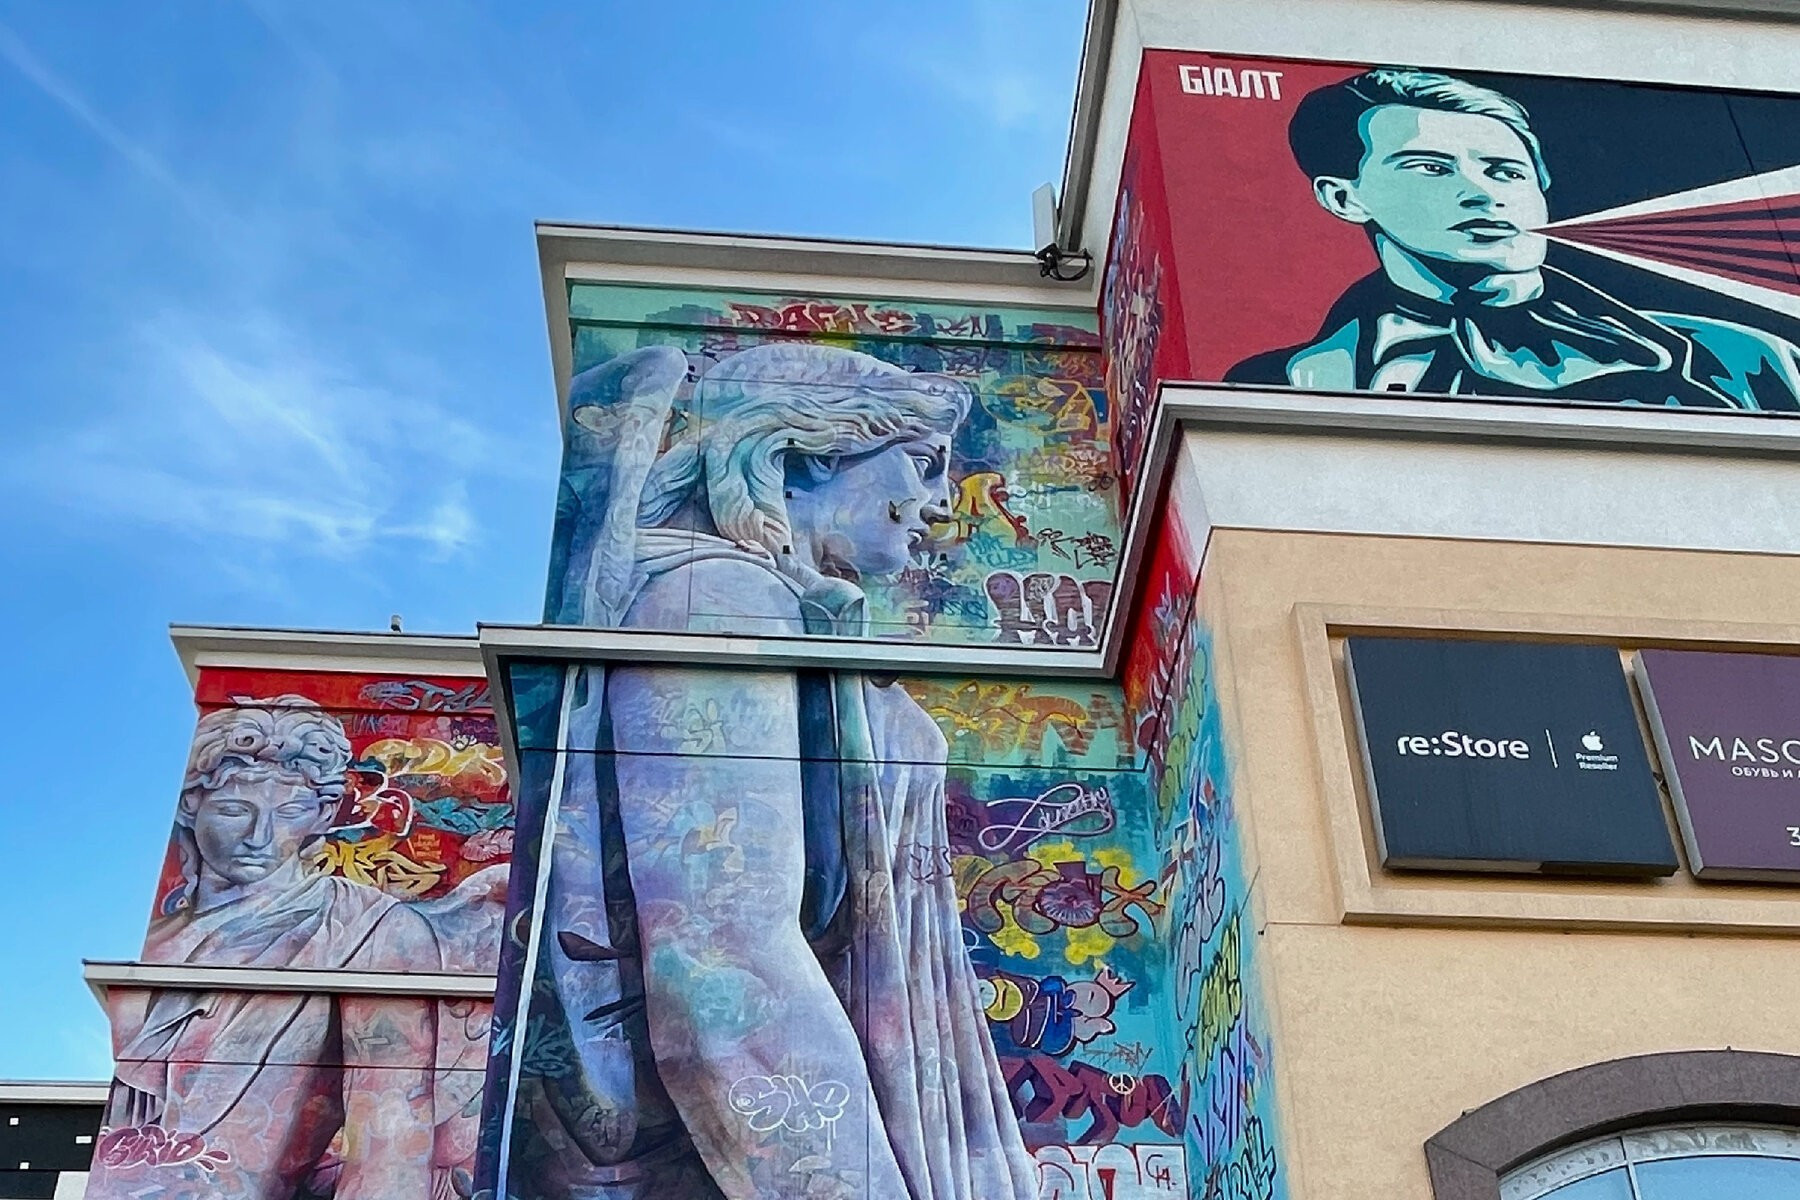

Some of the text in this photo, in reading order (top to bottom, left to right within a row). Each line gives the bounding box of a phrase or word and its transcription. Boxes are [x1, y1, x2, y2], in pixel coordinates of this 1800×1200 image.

[1397, 731, 1530, 760] re:Store
[1575, 752, 1619, 763] Premium
[1579, 761, 1618, 771] Reseller
[1731, 766, 1779, 779] ОБУВЬ
